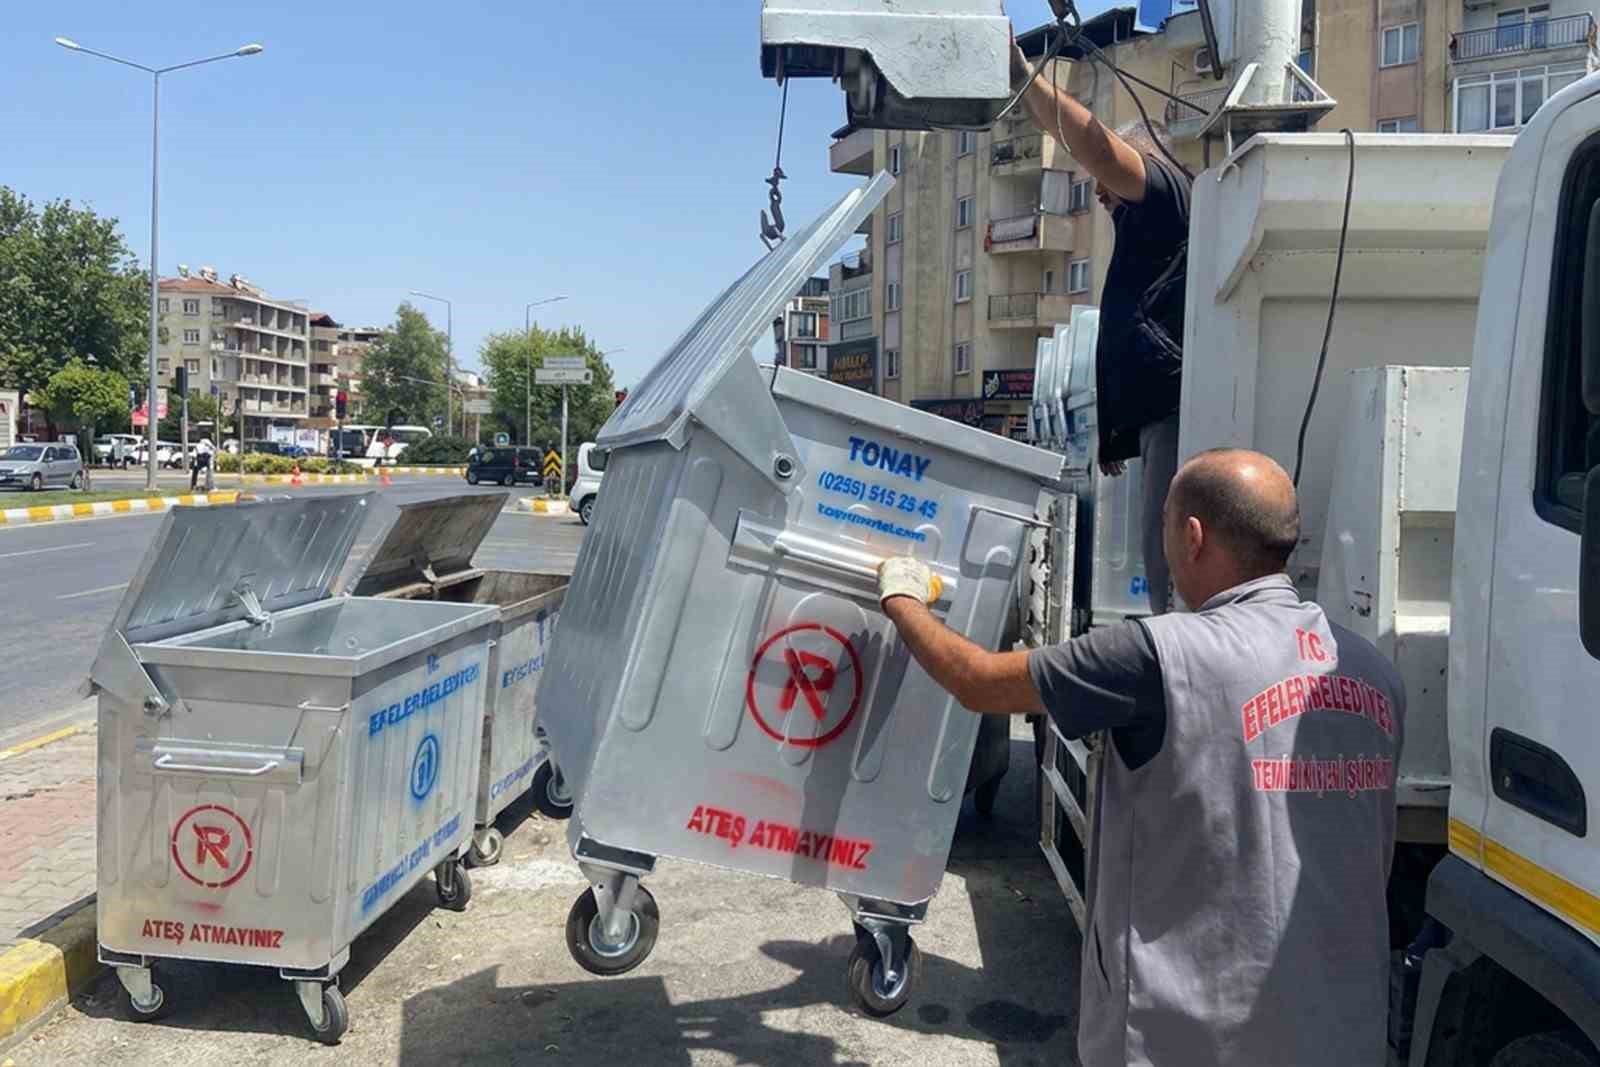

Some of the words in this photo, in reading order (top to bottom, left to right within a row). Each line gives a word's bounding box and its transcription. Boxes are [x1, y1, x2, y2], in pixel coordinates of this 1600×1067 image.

[848, 435, 932, 482] TONAY
[1241, 673, 1308, 744] EFELER
[686, 804, 747, 849] ATEŞ
[749, 820, 873, 870] ATMAYINIZ
[141, 918, 185, 945] ATEŞ
[189, 923, 285, 949] ATMAYINIZ
